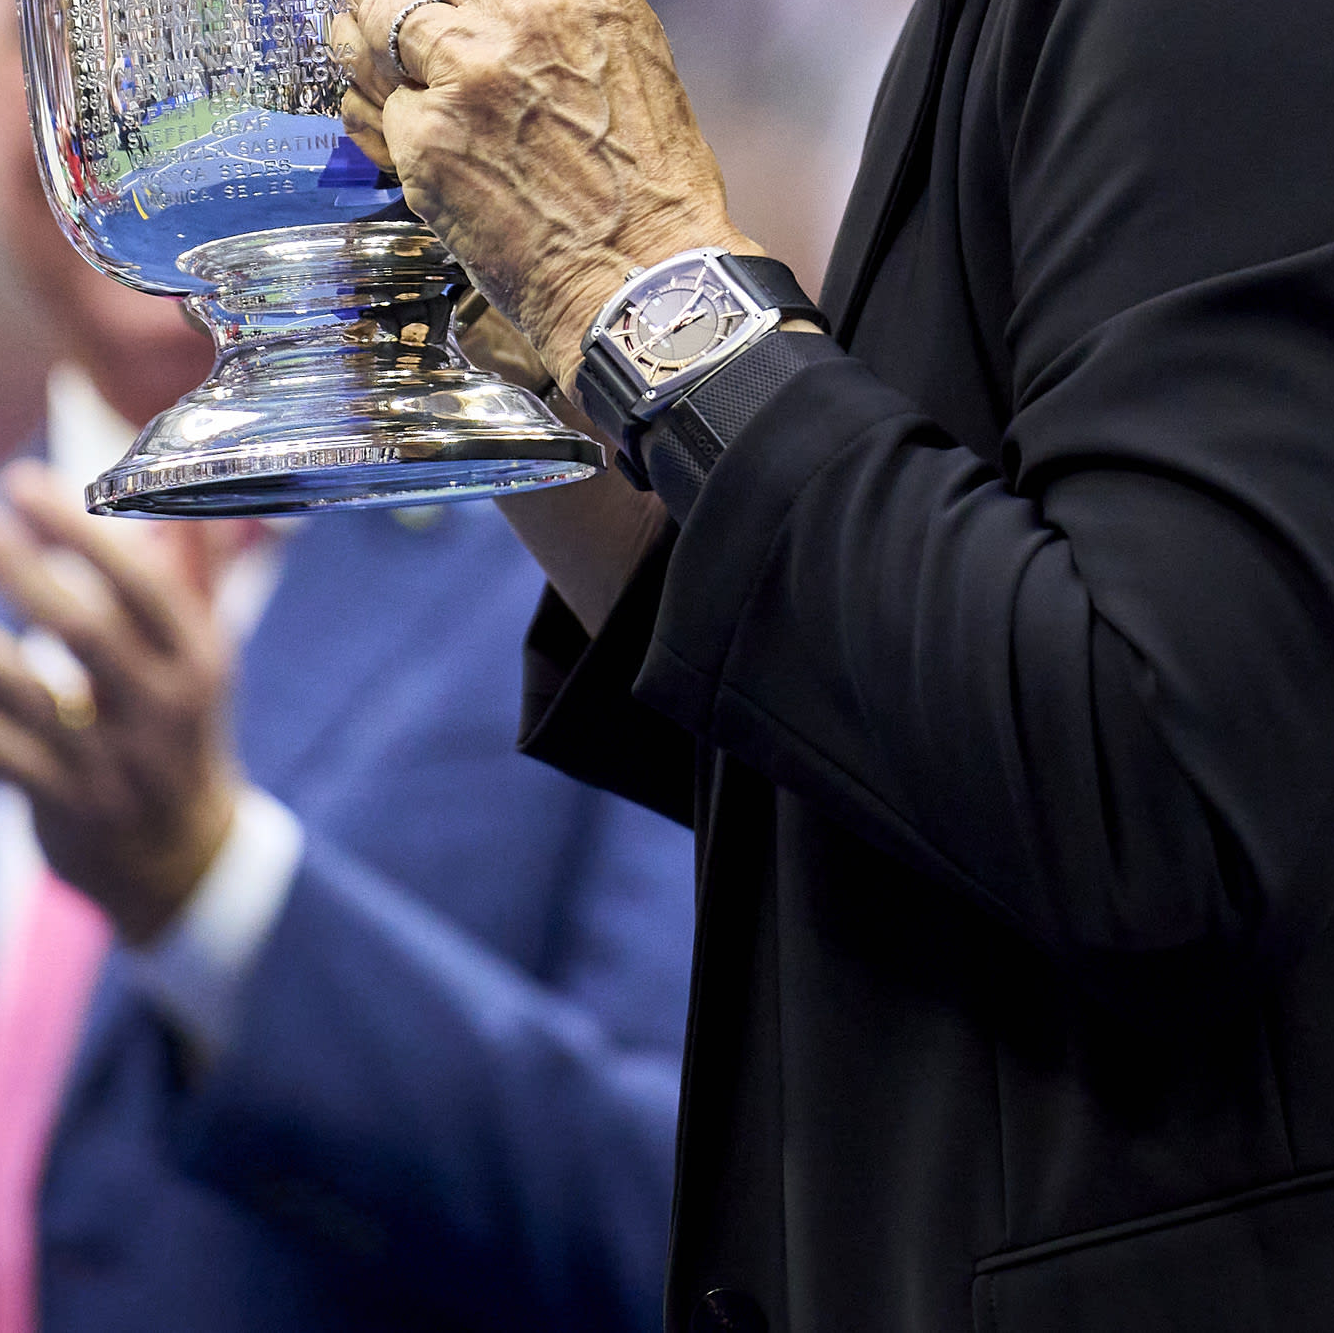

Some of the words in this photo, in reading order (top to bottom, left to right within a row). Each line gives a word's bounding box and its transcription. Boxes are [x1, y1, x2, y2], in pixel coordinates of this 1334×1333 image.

[205, 42, 358, 73] NAVRATILOVA
[211, 63, 357, 93] NAVRATILOVA
[123, 103, 197, 127] STEFFI
[208, 94, 267, 116] GRAF
[127, 125, 199, 150] STEFFI
[211, 116, 271, 138] GRAF
[133, 143, 228, 167] GABRIELA
[237, 132, 339, 157] SABATINI
[219, 159, 292, 180] SELES
[146, 187, 215, 209] MONICA
[223, 179, 295, 200] SELES
